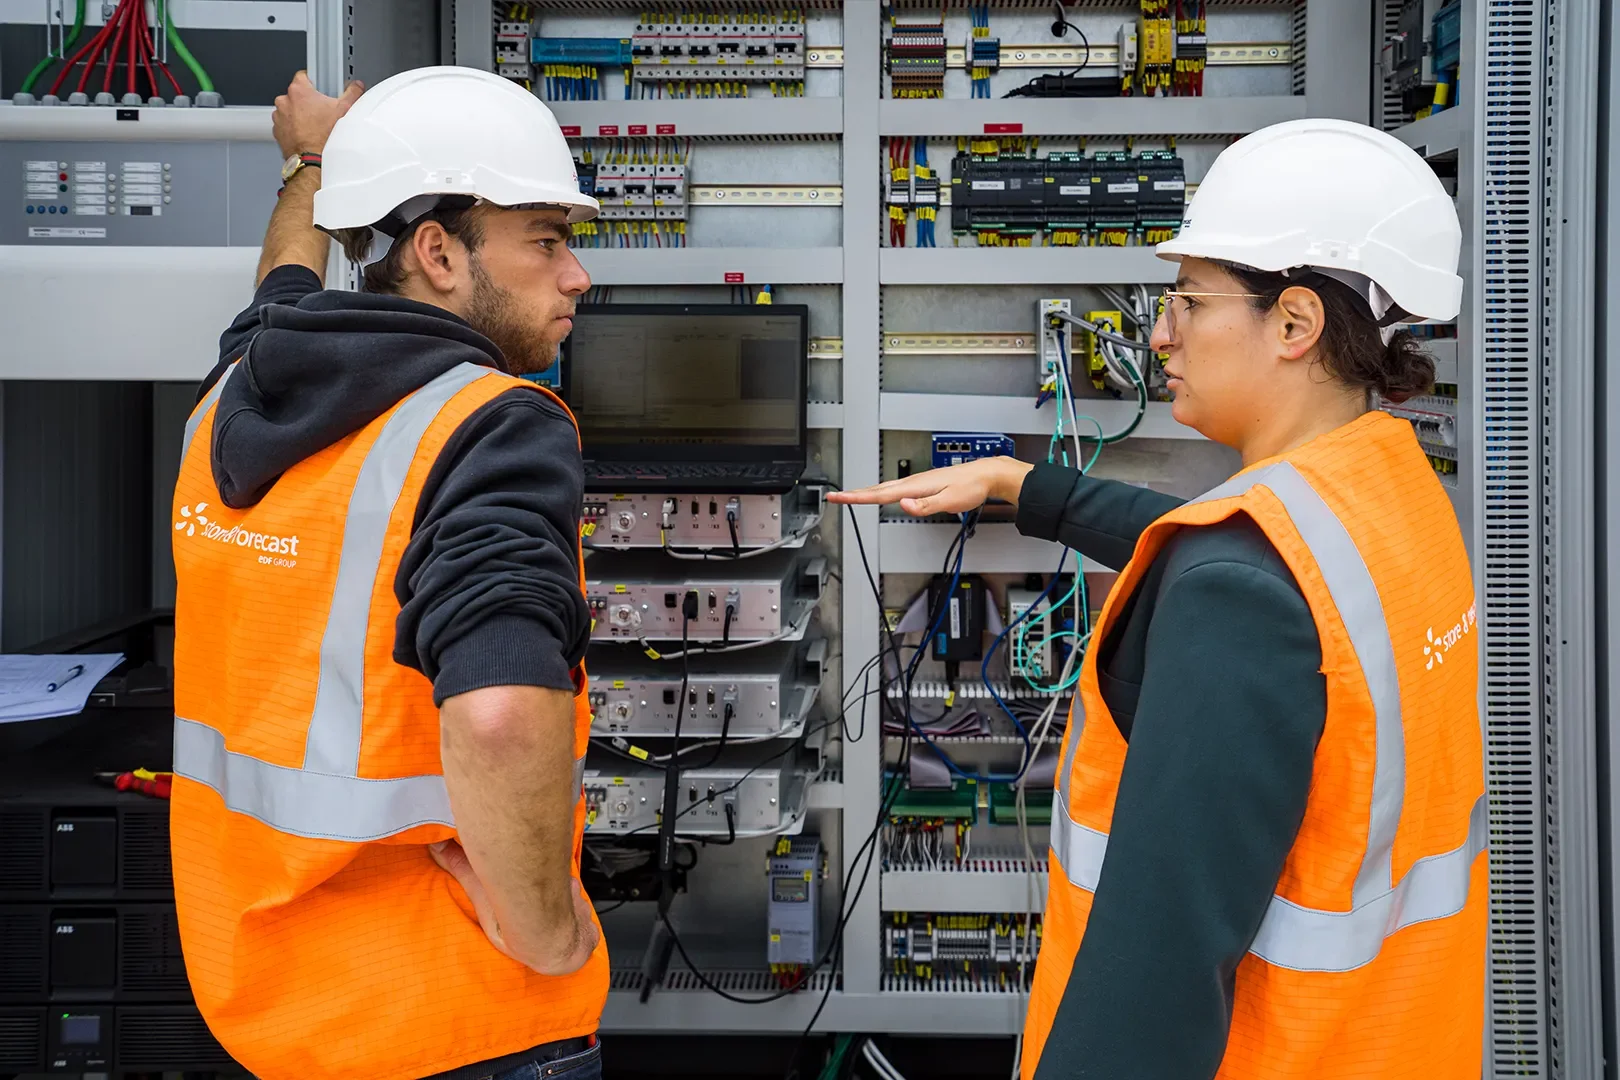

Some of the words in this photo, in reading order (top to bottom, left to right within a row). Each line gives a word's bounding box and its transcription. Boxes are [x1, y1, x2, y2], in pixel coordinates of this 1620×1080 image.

[274, 557, 297, 569] GROUP
[57, 824, 74, 832] ABB
[56, 926, 73, 934] ABB
